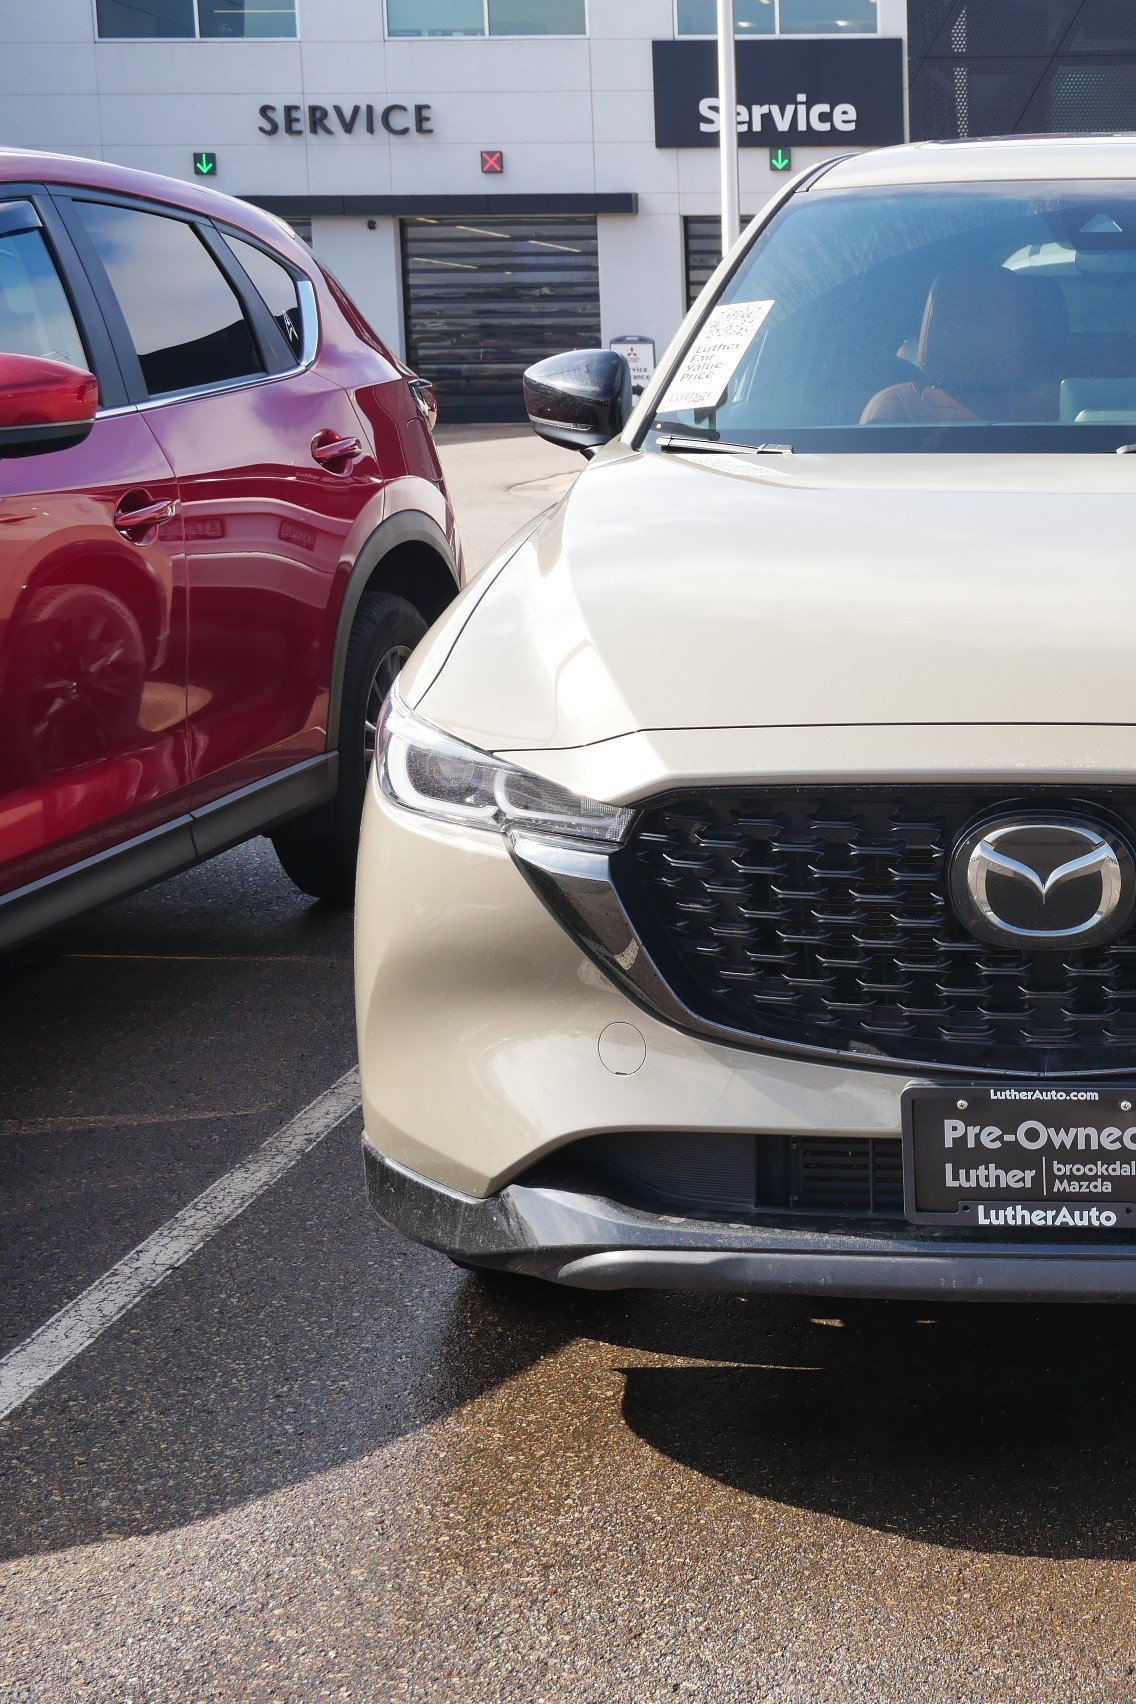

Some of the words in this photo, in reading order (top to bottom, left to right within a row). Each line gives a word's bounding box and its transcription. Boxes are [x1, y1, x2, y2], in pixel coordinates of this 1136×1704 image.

[258, 104, 434, 136] SERVICE
[698, 93, 857, 133] Service
[990, 1088, 1099, 1101] LutherAuto.com
[945, 1162, 1037, 1189] Luther
[1052, 1178, 1112, 1193] Mazda
[977, 1204, 1118, 1227] LutherAuto
